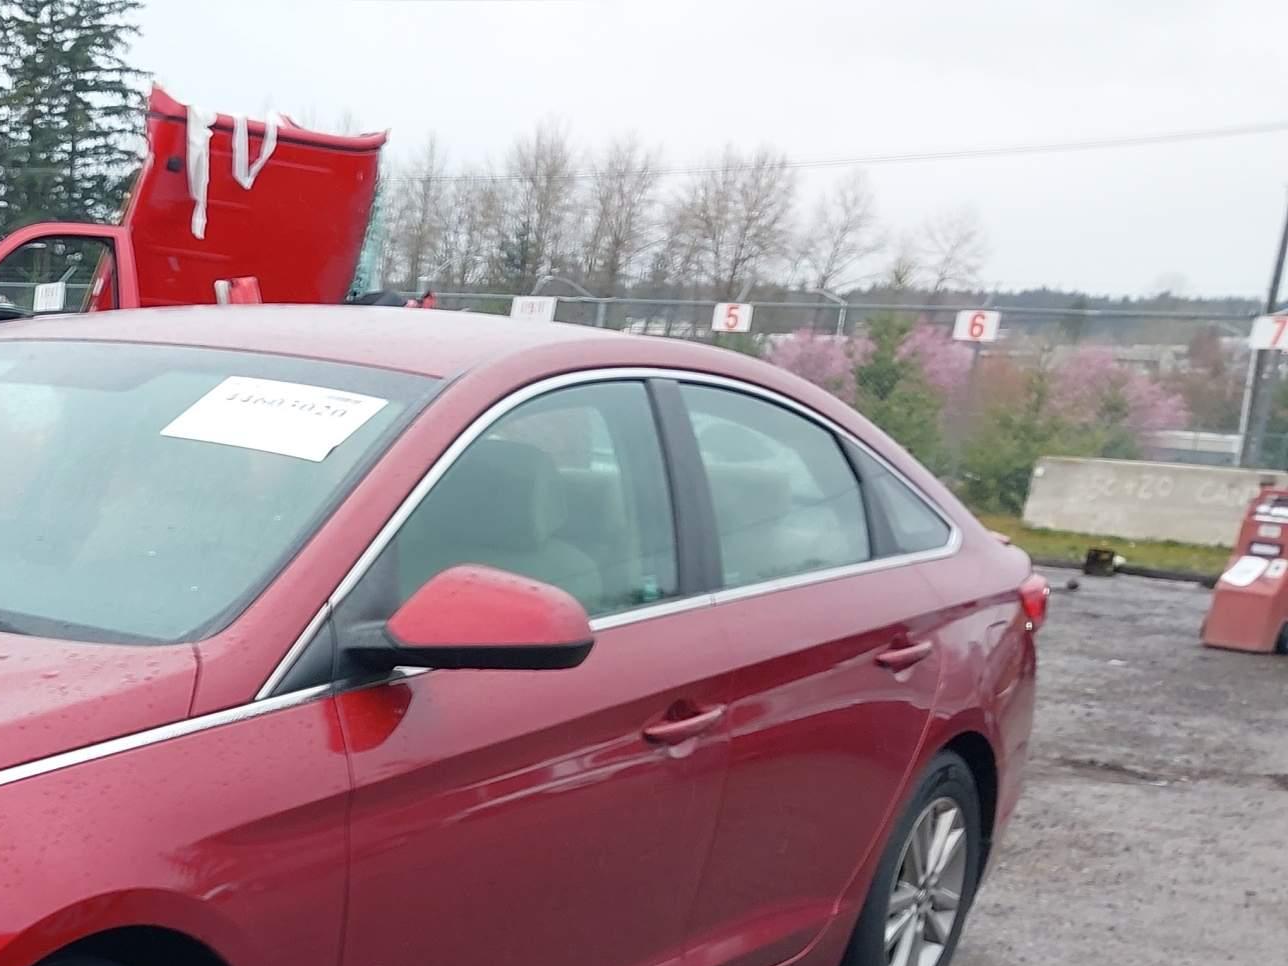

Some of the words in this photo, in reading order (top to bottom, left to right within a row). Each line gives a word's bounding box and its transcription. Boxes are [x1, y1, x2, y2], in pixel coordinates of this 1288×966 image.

[726, 304, 739, 330] 5
[970, 312, 985, 339] 6
[1271, 317, 1288, 349] 7
